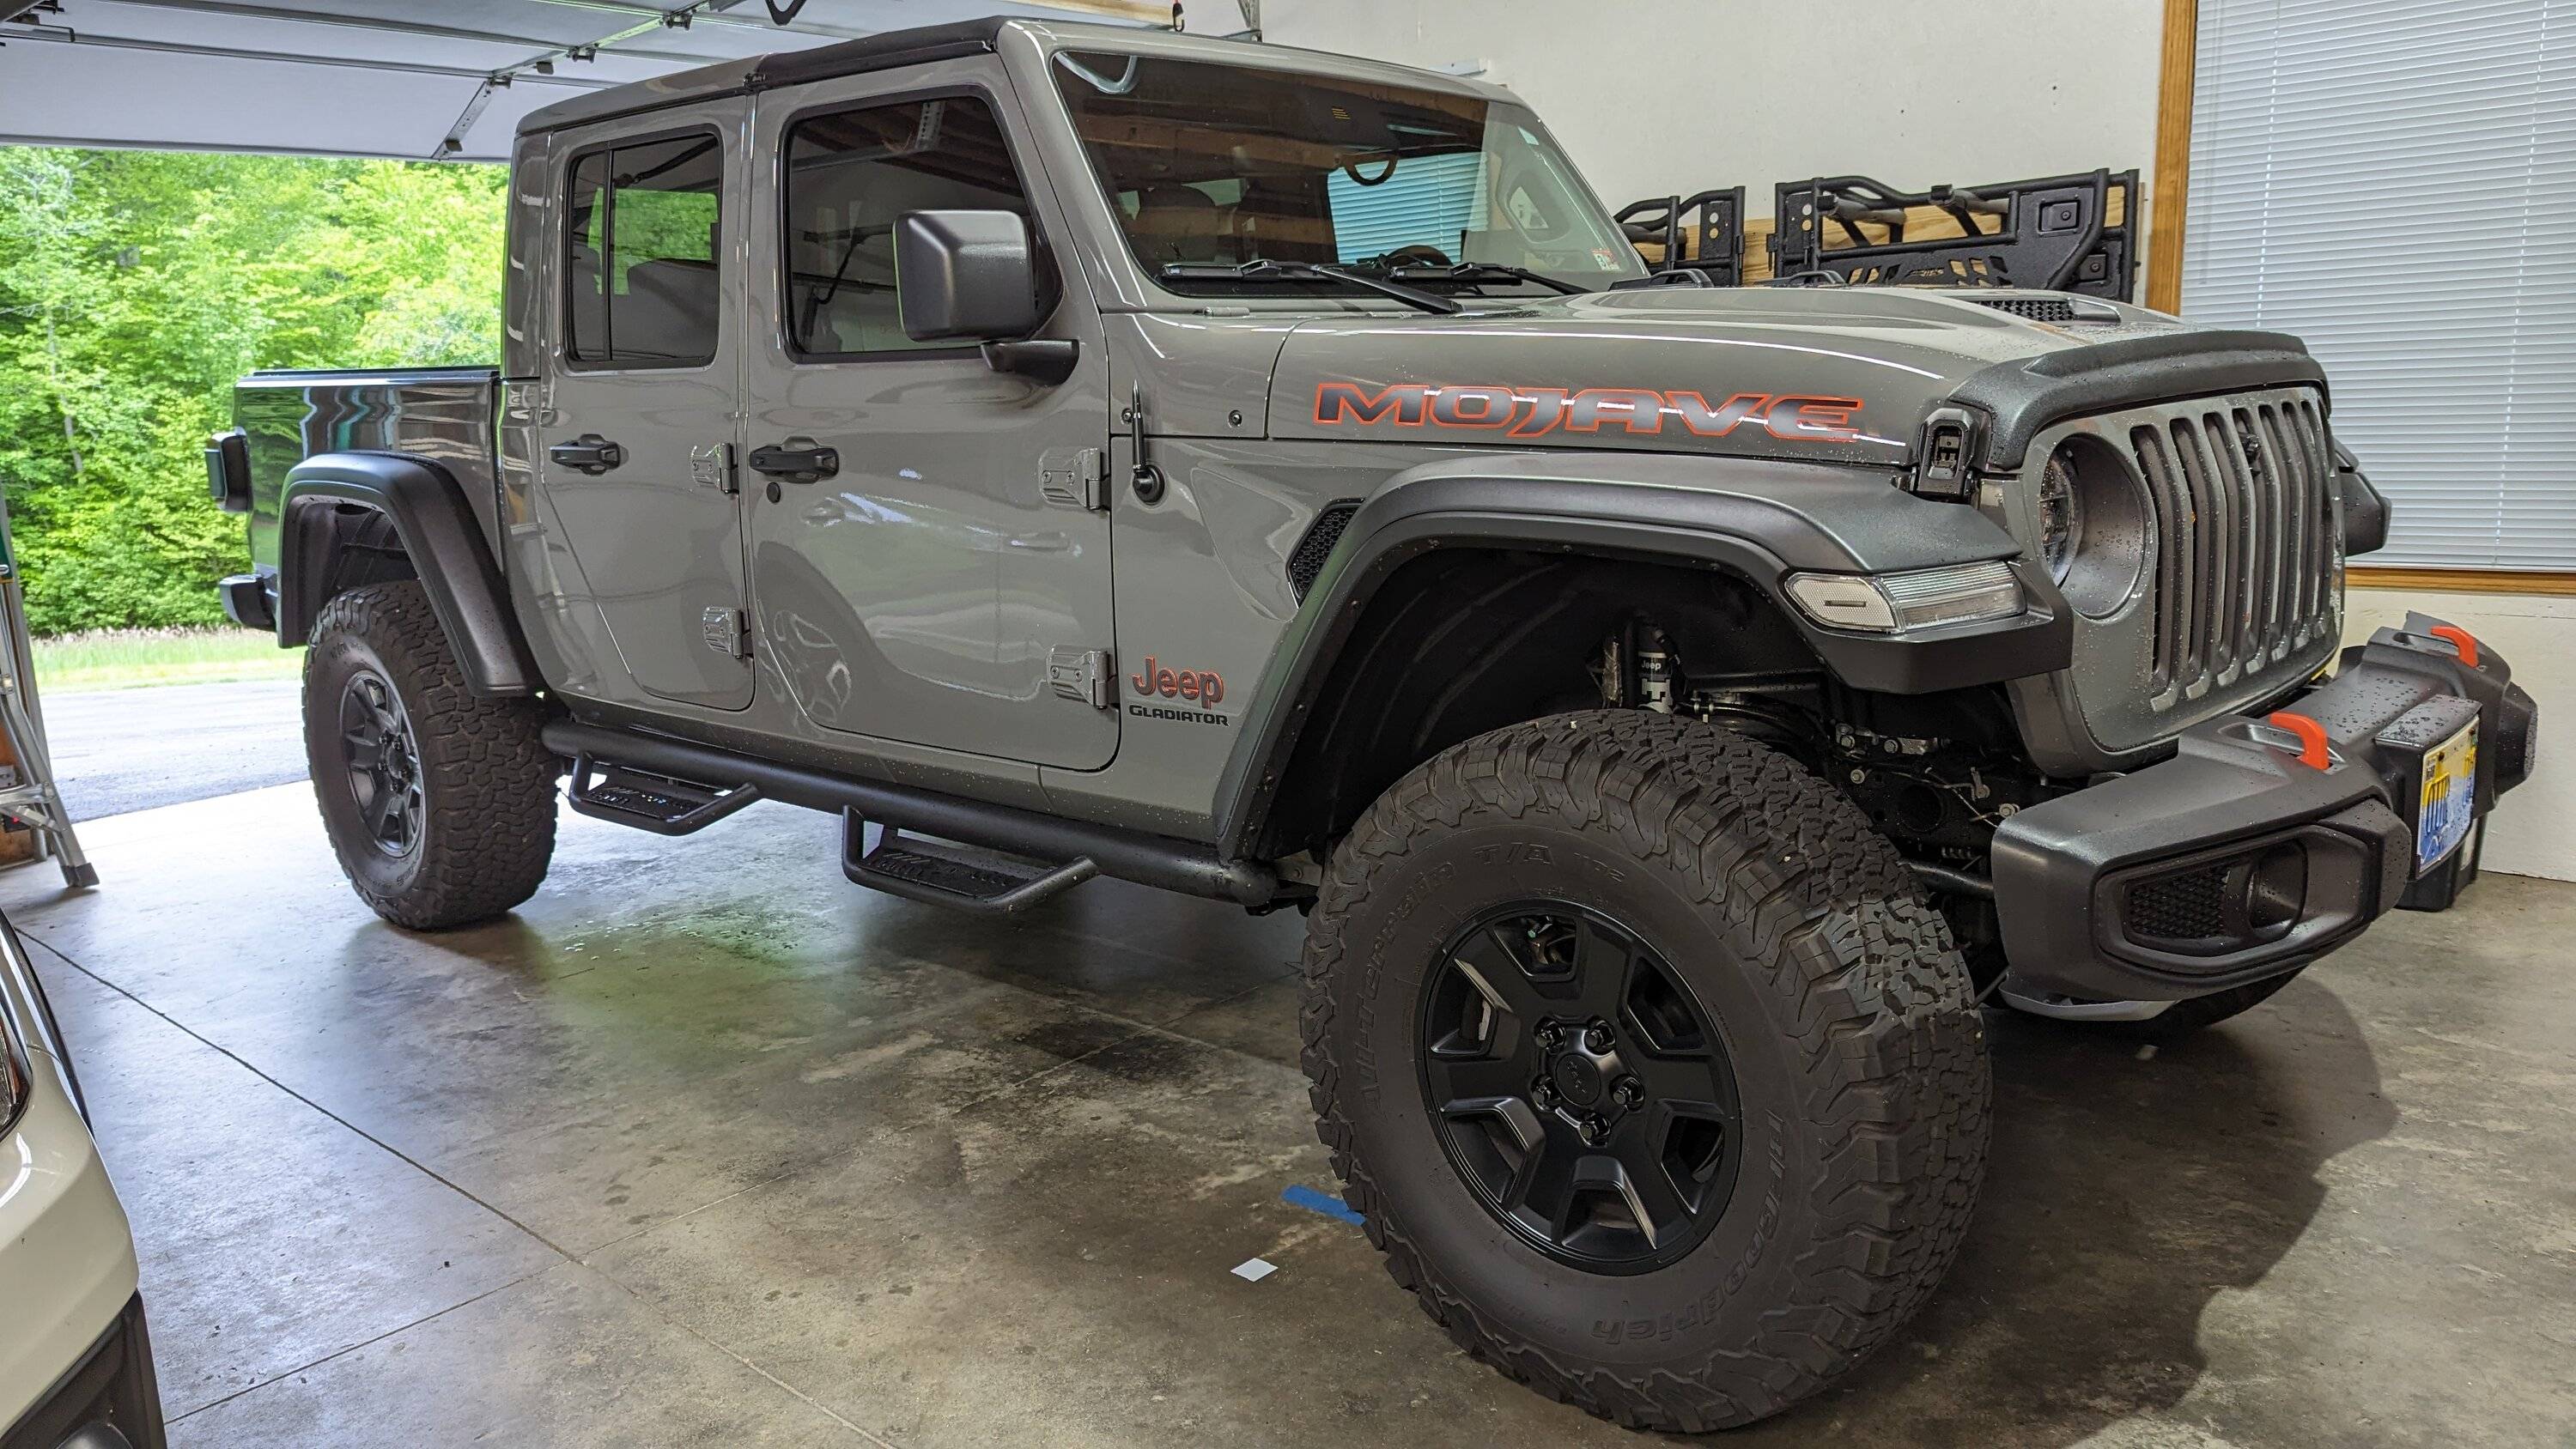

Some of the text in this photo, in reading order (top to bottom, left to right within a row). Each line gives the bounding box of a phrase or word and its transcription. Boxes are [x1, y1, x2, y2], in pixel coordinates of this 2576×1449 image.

[1314, 383, 1864, 442] MOJAVE
[1642, 659, 1662, 670] Jeep
[1131, 656, 1224, 710] Jeep
[1129, 704, 1230, 726] GLADIATOR
[1471, 839, 1556, 865] T/A
